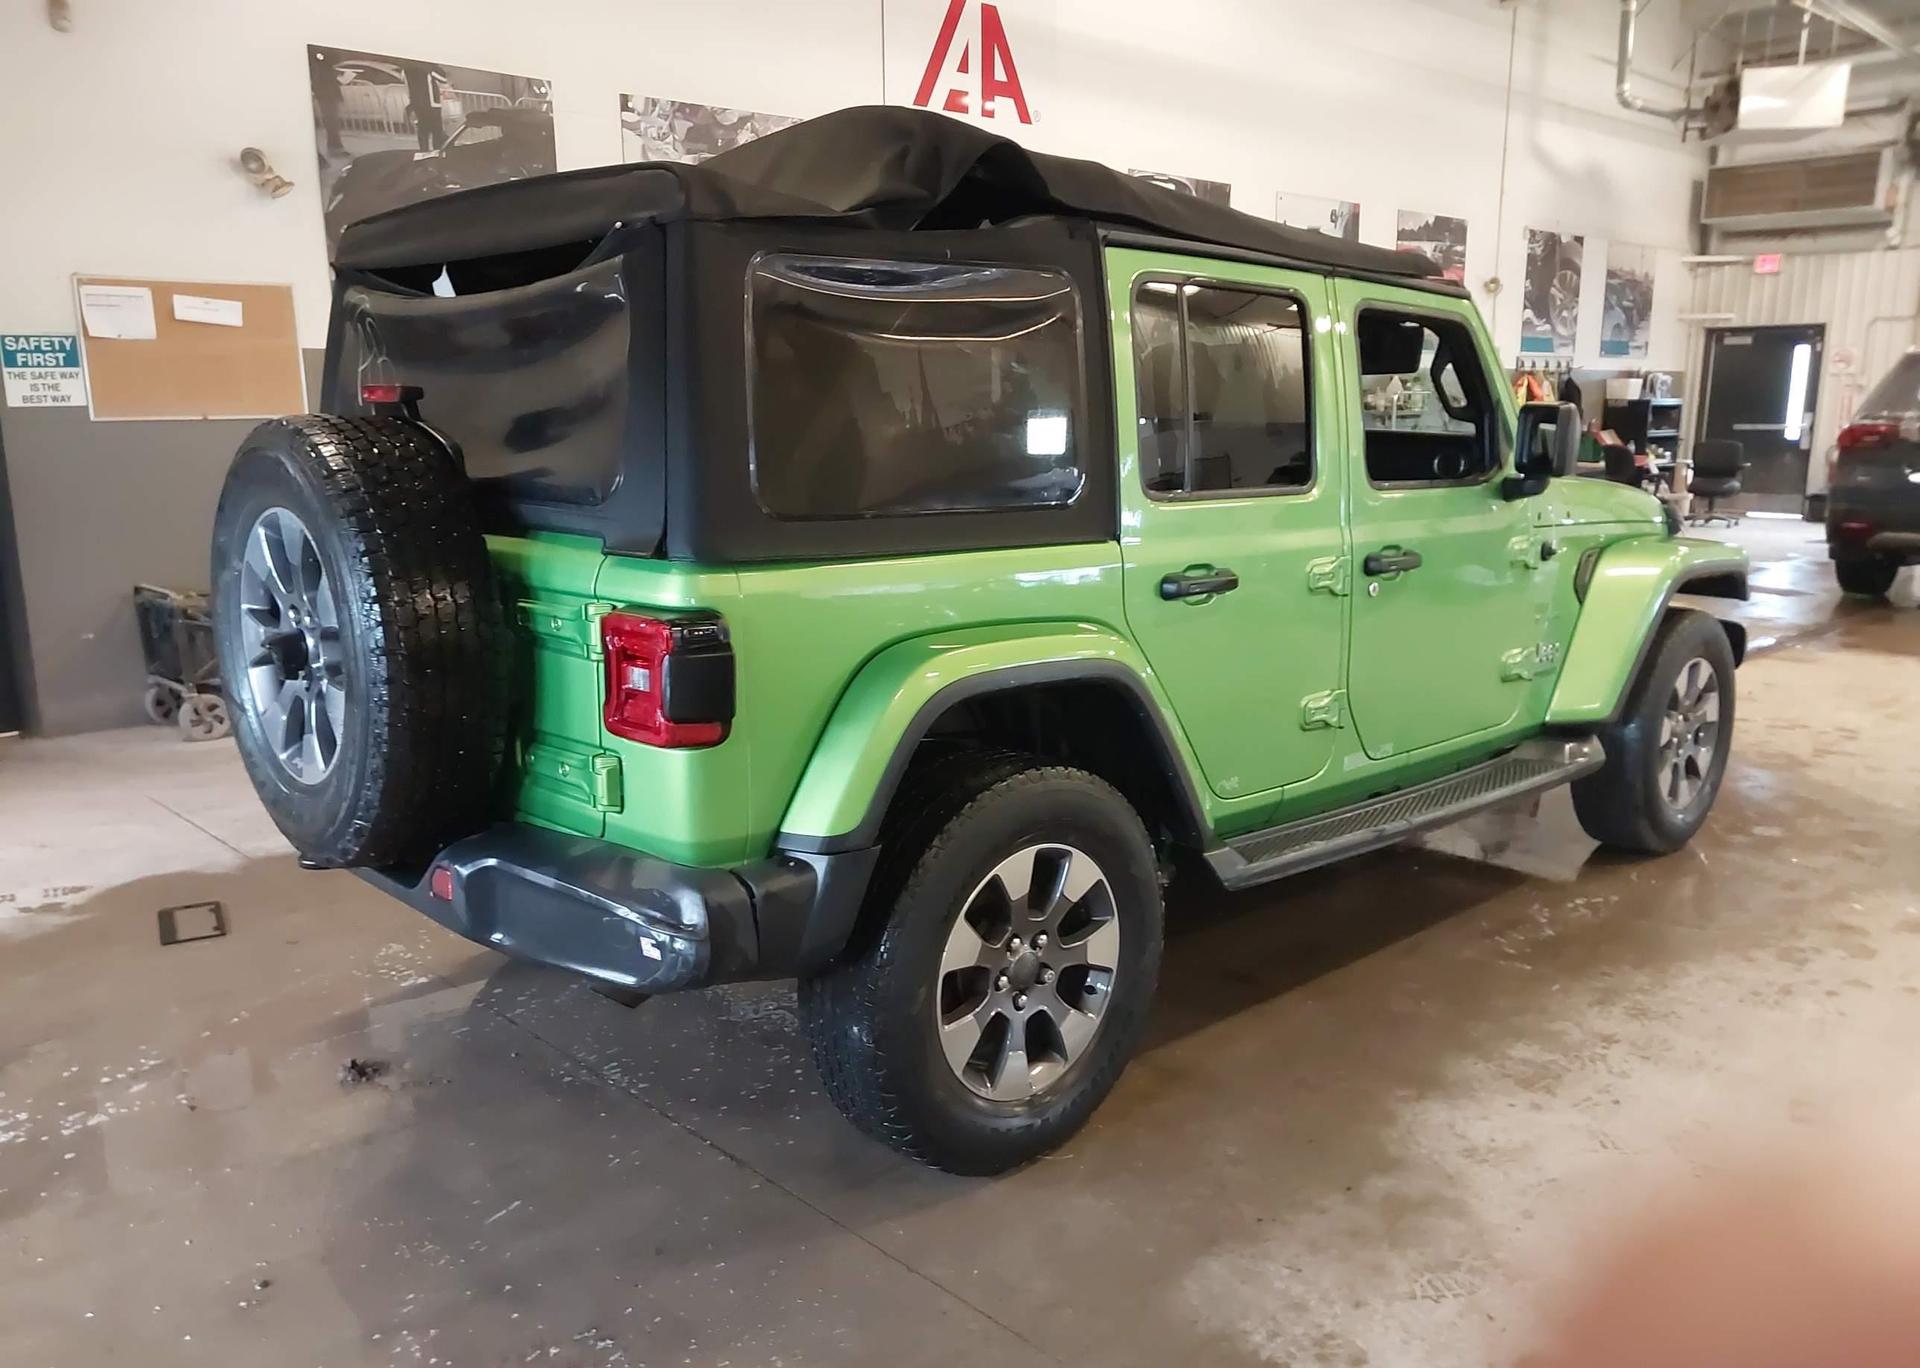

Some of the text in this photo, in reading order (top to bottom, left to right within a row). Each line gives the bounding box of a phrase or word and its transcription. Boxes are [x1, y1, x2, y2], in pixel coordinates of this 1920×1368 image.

[3, 336, 73, 351] SAFETY
[16, 352, 67, 367] FIRST
[7, 371, 80, 380] THE SAFE WAY
[29, 383, 61, 392] IS THE
[22, 394, 72, 404] BEST WAY
